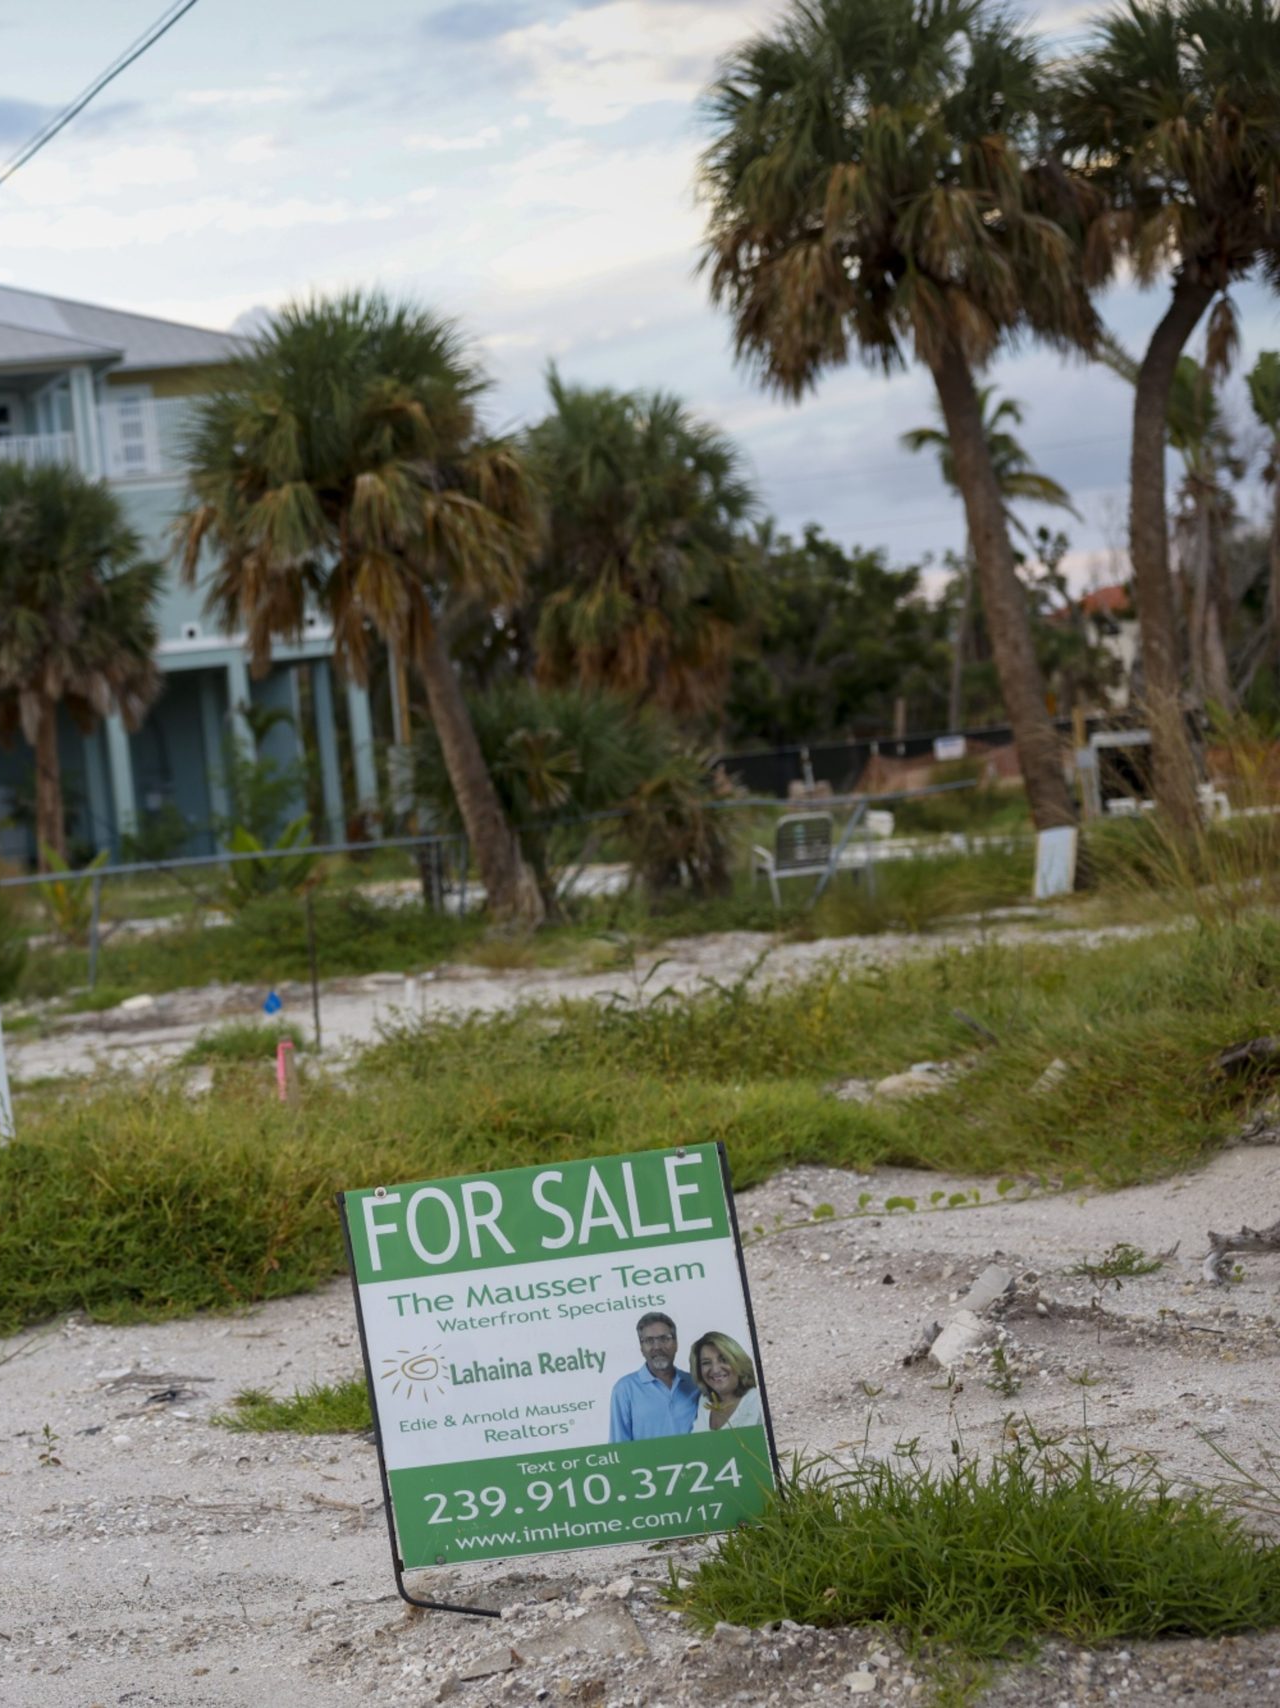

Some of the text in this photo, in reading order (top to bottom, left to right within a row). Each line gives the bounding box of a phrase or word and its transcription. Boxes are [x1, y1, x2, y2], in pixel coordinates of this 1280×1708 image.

[361, 1153, 714, 1272] FOR SALE
[387, 1261, 707, 1318] The Mausser Team
[436, 1291, 666, 1334] Waterfront Specialists
[450, 1347, 607, 1387] Lahaina Realty
[399, 1400, 596, 1434] Edie & Arnold Mausser
[517, 1450, 621, 1476] Text or Call
[423, 1456, 743, 1526] 239.910.3724
[455, 1502, 723, 1550] www.imHome.com/17
